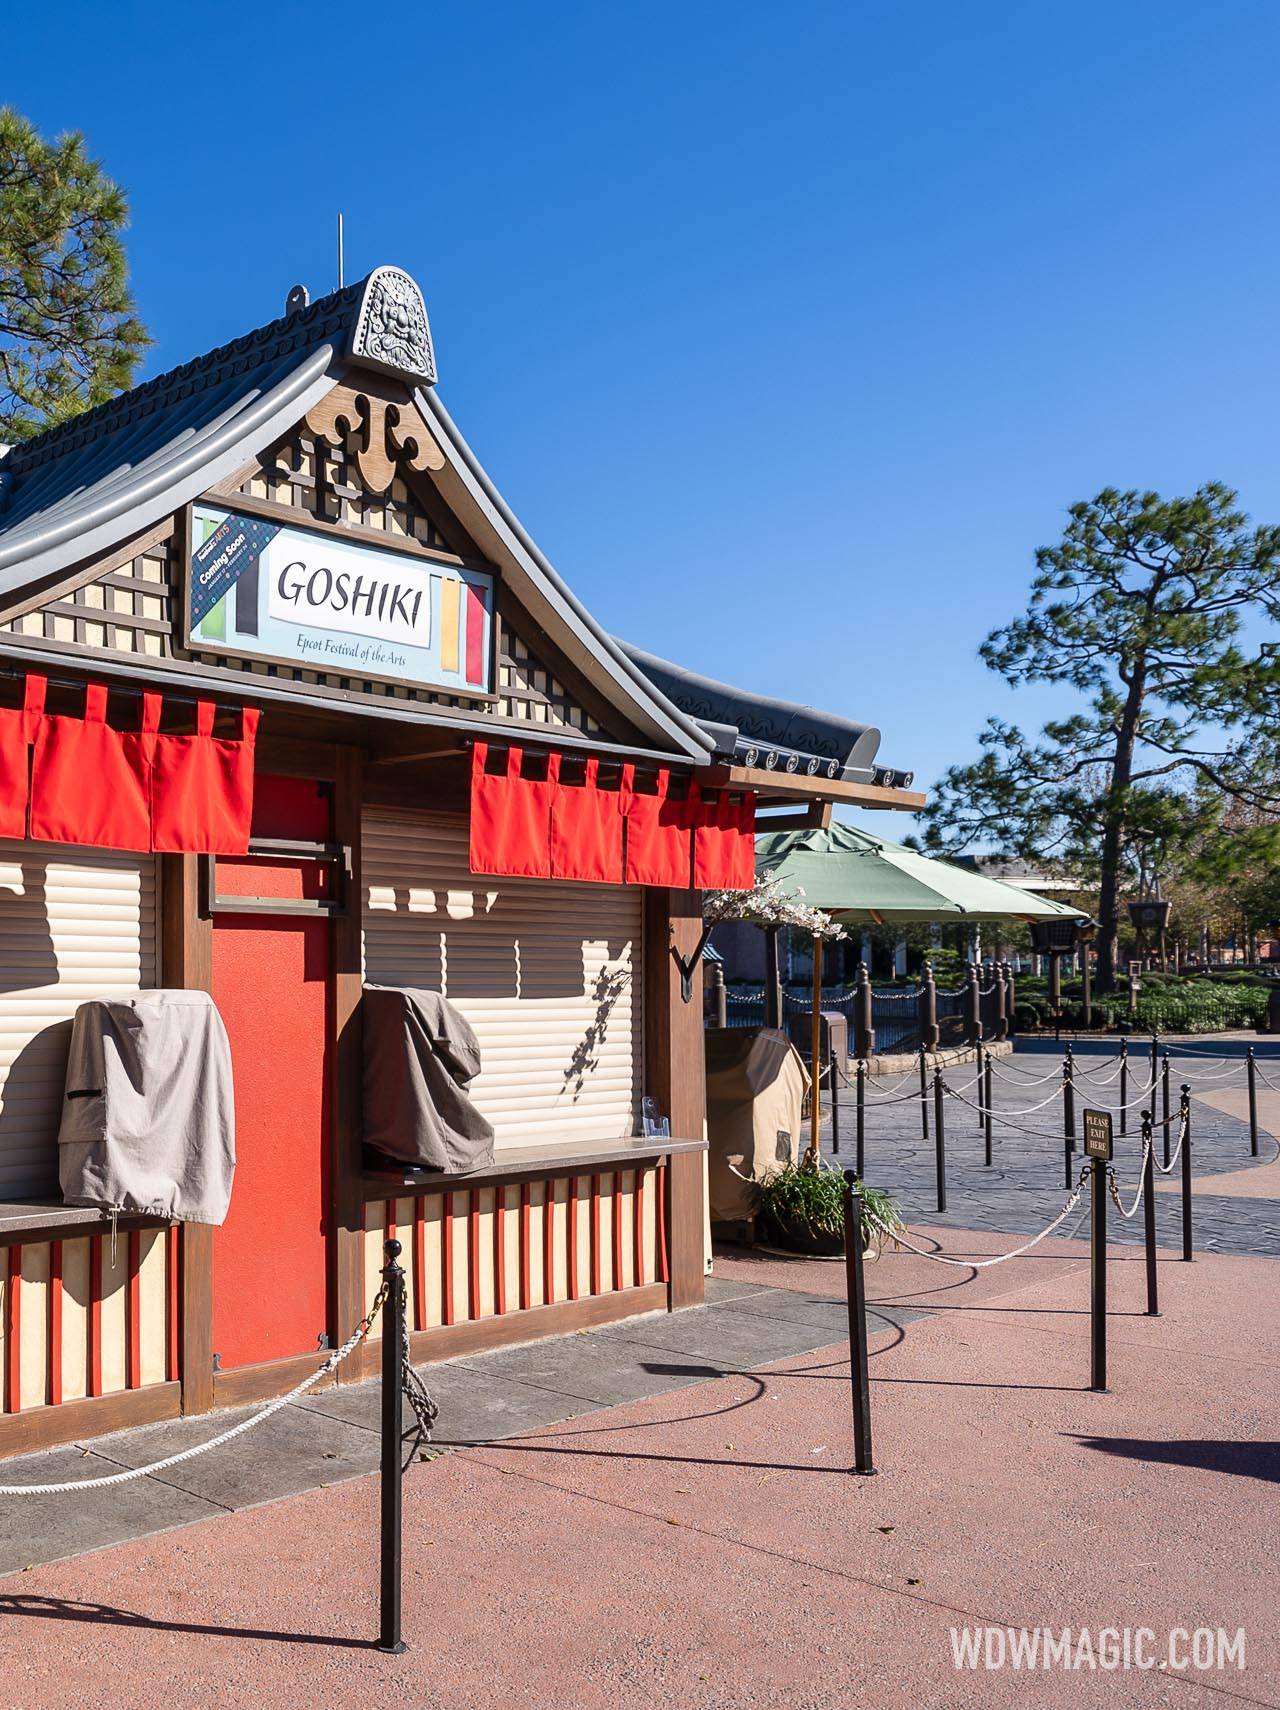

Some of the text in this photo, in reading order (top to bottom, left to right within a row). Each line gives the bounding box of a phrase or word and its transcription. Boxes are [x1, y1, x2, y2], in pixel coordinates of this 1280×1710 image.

[200, 553, 228, 584] Coming
[226, 534, 245, 555] Soon
[278, 561, 423, 629] GOSHIKI
[296, 633, 407, 665] Epcot Festival of the Arts
[1086, 1116, 1109, 1127] PLEASE
[1090, 1128, 1105, 1139] EXIT
[1089, 1140, 1106, 1151] HERE
